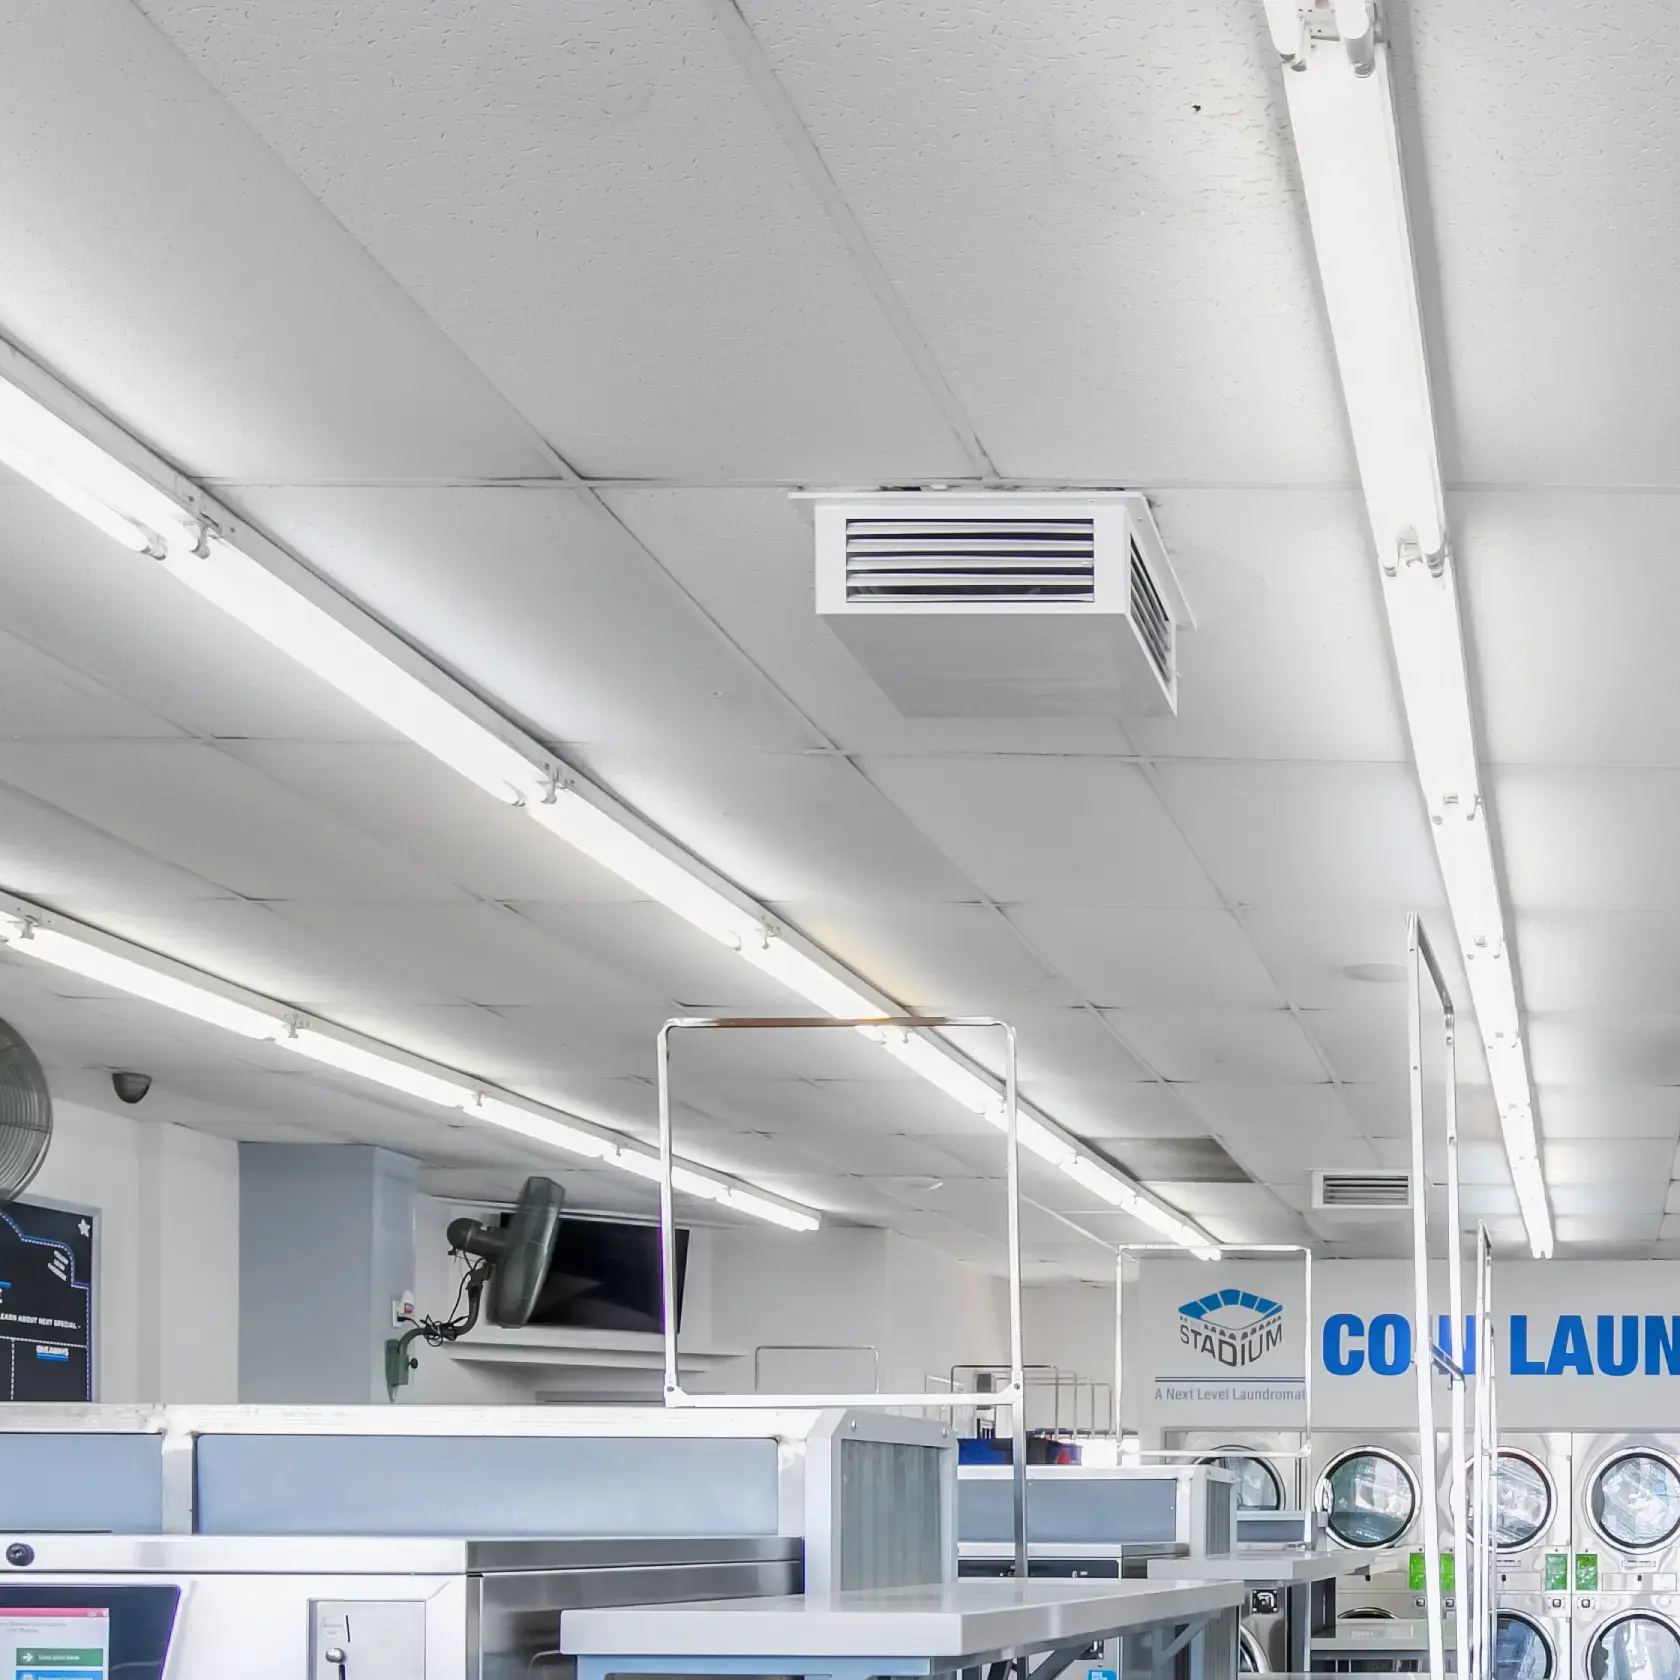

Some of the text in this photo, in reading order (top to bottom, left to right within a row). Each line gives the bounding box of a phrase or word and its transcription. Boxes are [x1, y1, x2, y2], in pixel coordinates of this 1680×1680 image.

[1180, 1322, 1282, 1367] STADIUM
[1322, 1313, 1477, 1377] CON
[1155, 1388, 1306, 1400] A Next Level Laundromat
